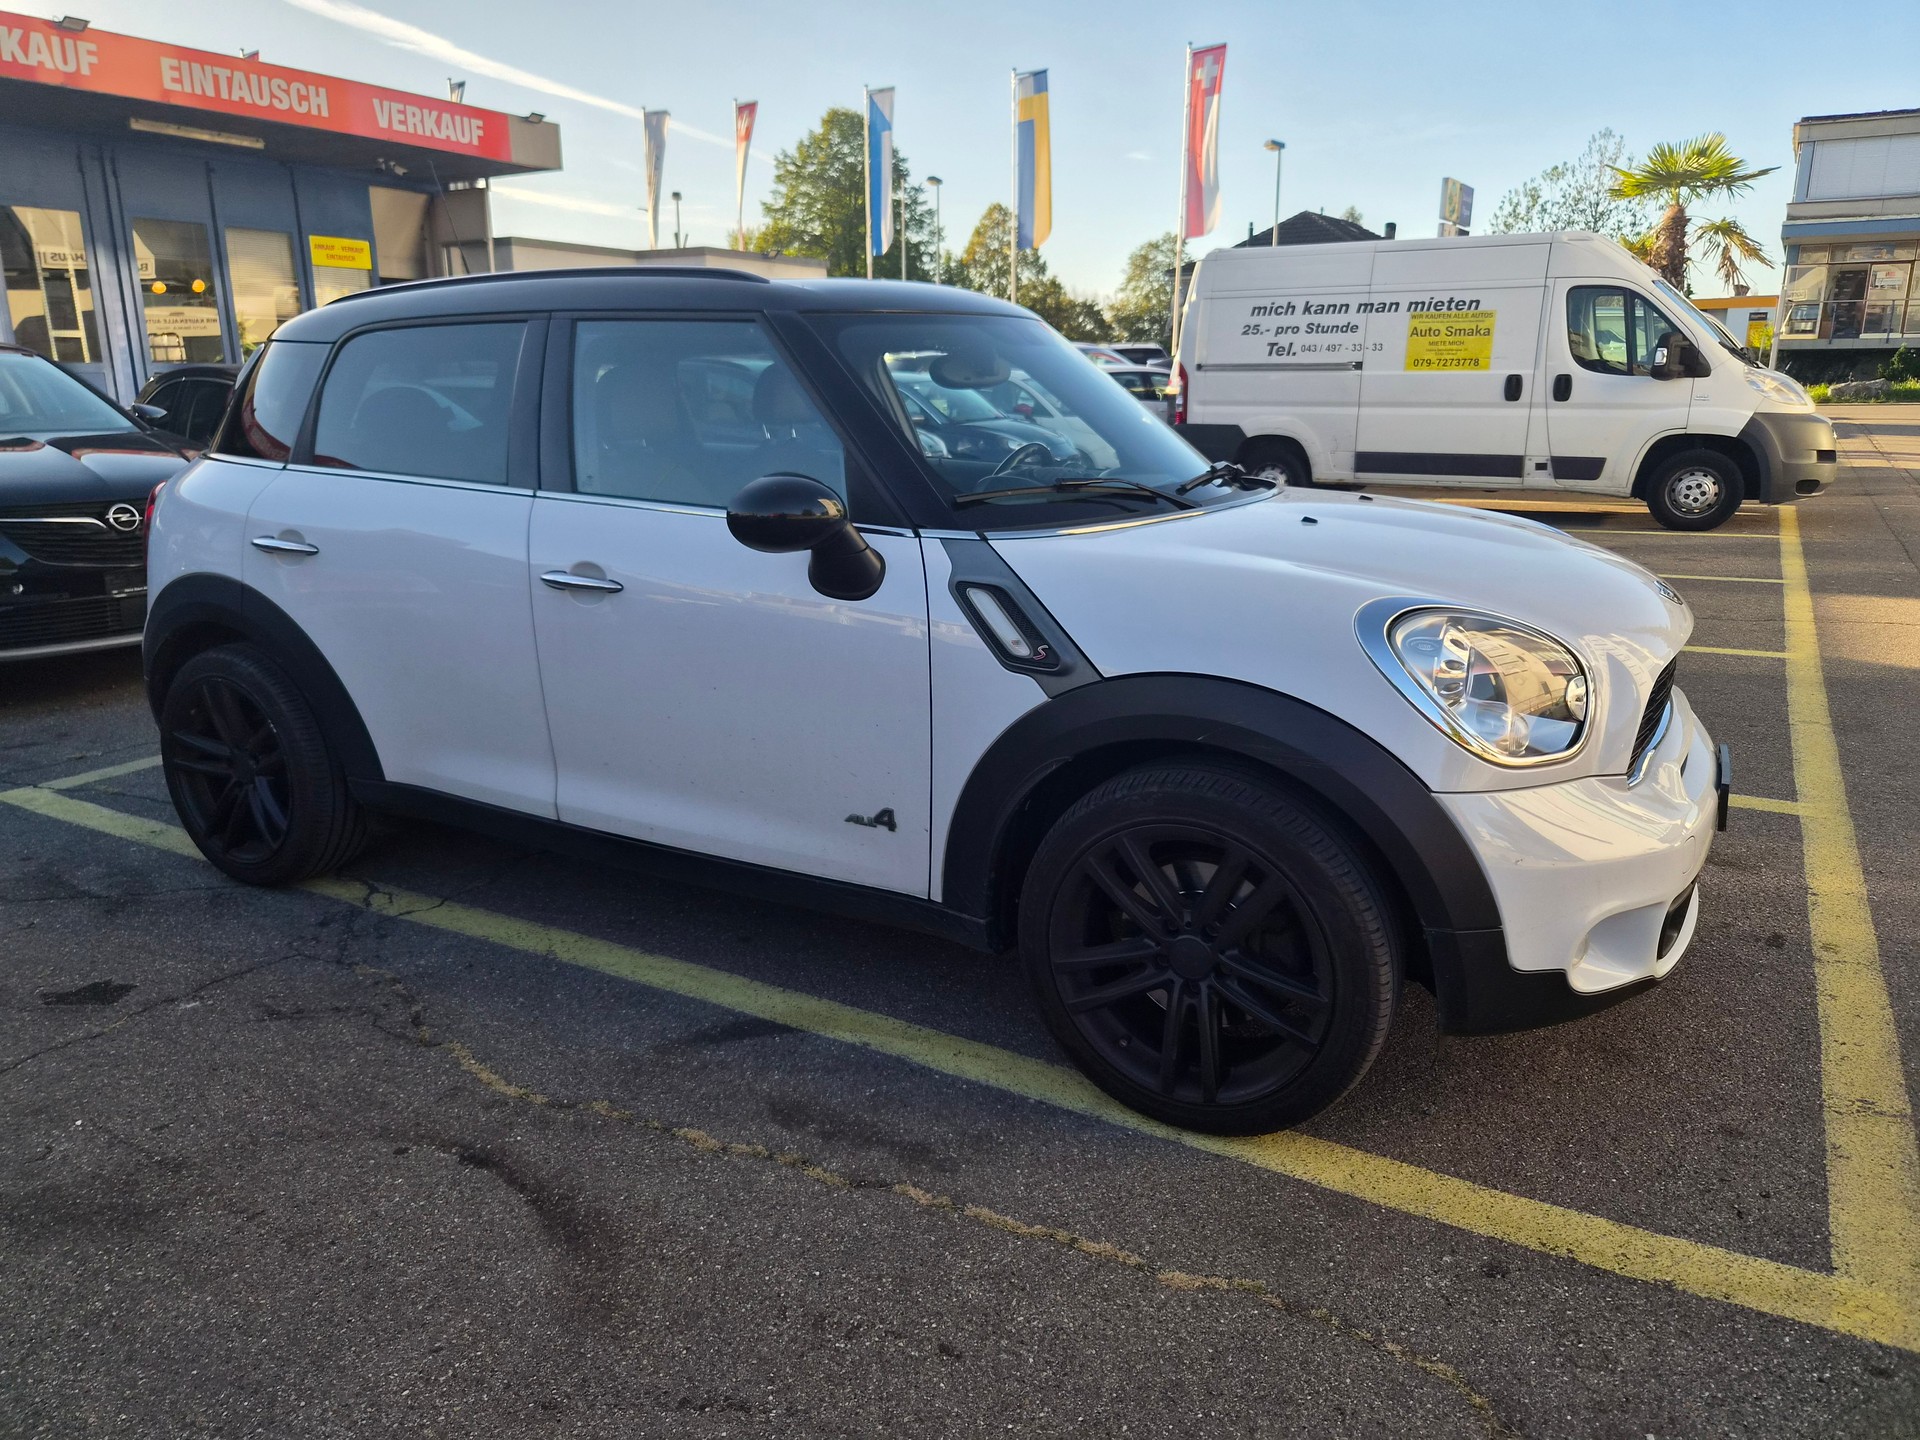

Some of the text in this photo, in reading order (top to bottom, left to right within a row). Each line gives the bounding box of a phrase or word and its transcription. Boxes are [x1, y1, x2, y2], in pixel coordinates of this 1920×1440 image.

[0, 25, 484, 146] KAUF EINTAUSCH VERKAUF
[1250, 297, 1480, 317] mich kann man mieten
[1241, 322, 1359, 337] 25.- pro Stunde
[1410, 325, 1491, 337] Auto Smaka
[1266, 342, 1297, 357] Tel.
[1300, 344, 1317, 352] 043
[1325, 344, 1342, 352] 497
[1351, 343, 1363, 352] 33
[1371, 343, 1384, 352] 33
[1413, 358, 1480, 367] 079-7273778
[1033, 645, 1049, 660] S
